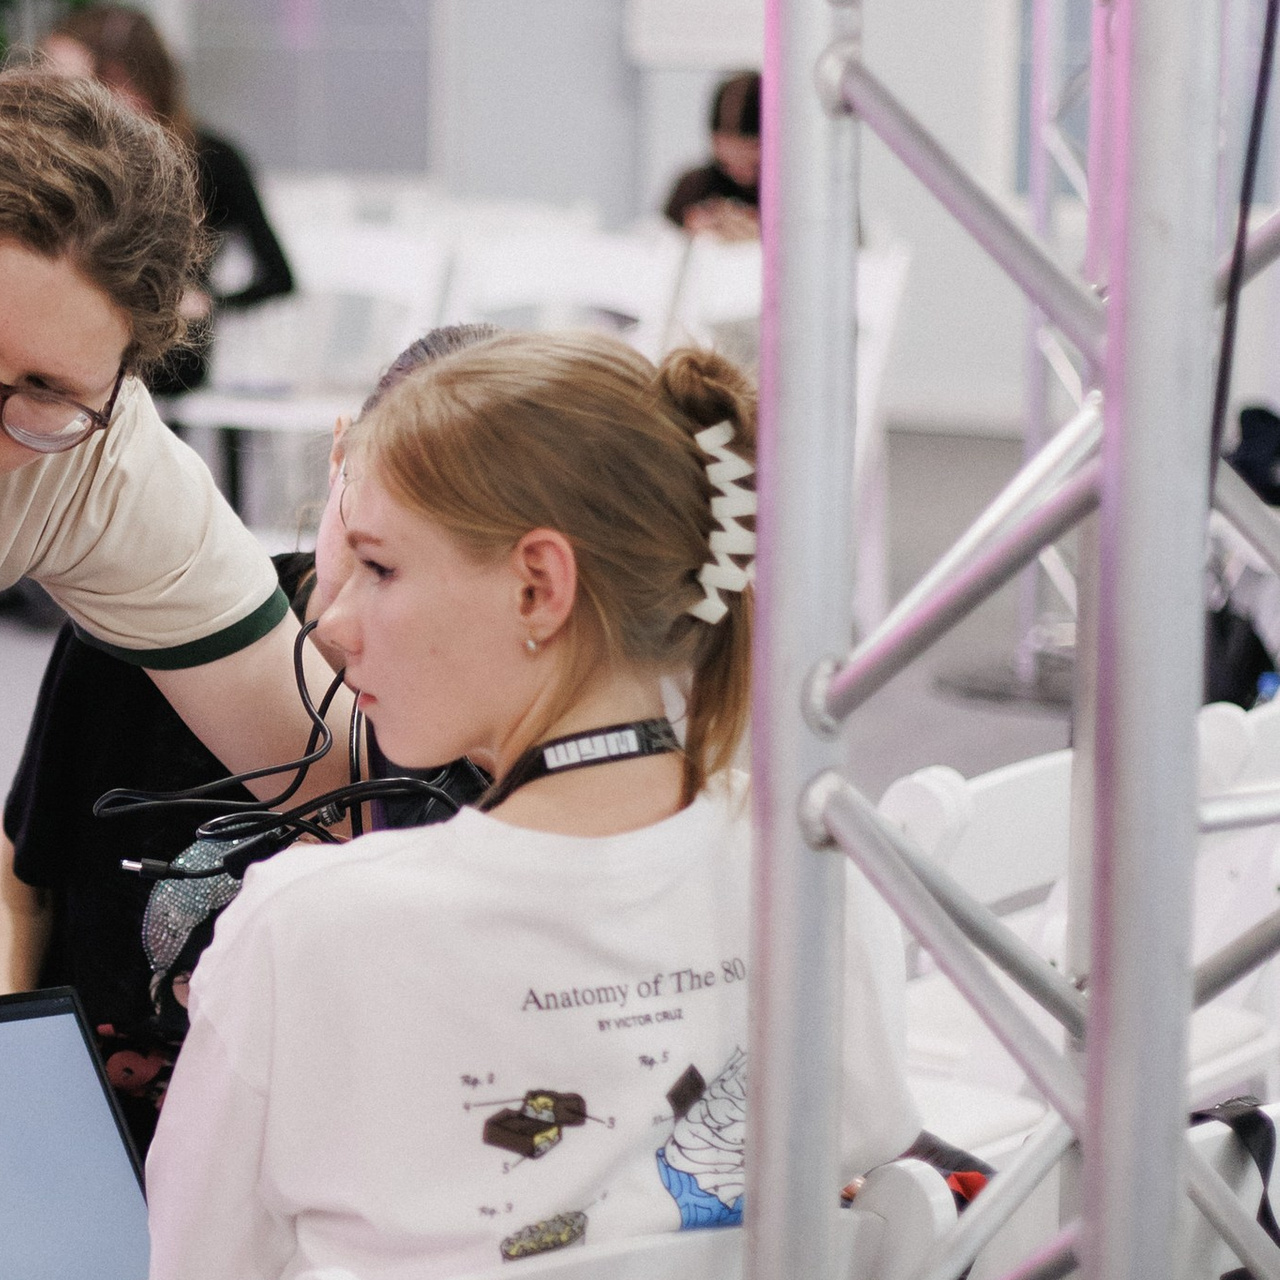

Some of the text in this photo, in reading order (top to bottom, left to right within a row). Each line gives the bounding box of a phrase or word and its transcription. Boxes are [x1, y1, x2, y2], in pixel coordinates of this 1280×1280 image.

[522, 984, 629, 1011] Anatomy
[637, 973, 663, 998] of
[670, 968, 715, 994] The
[598, 1009, 684, 1032] BY VICTOR CRUZ
